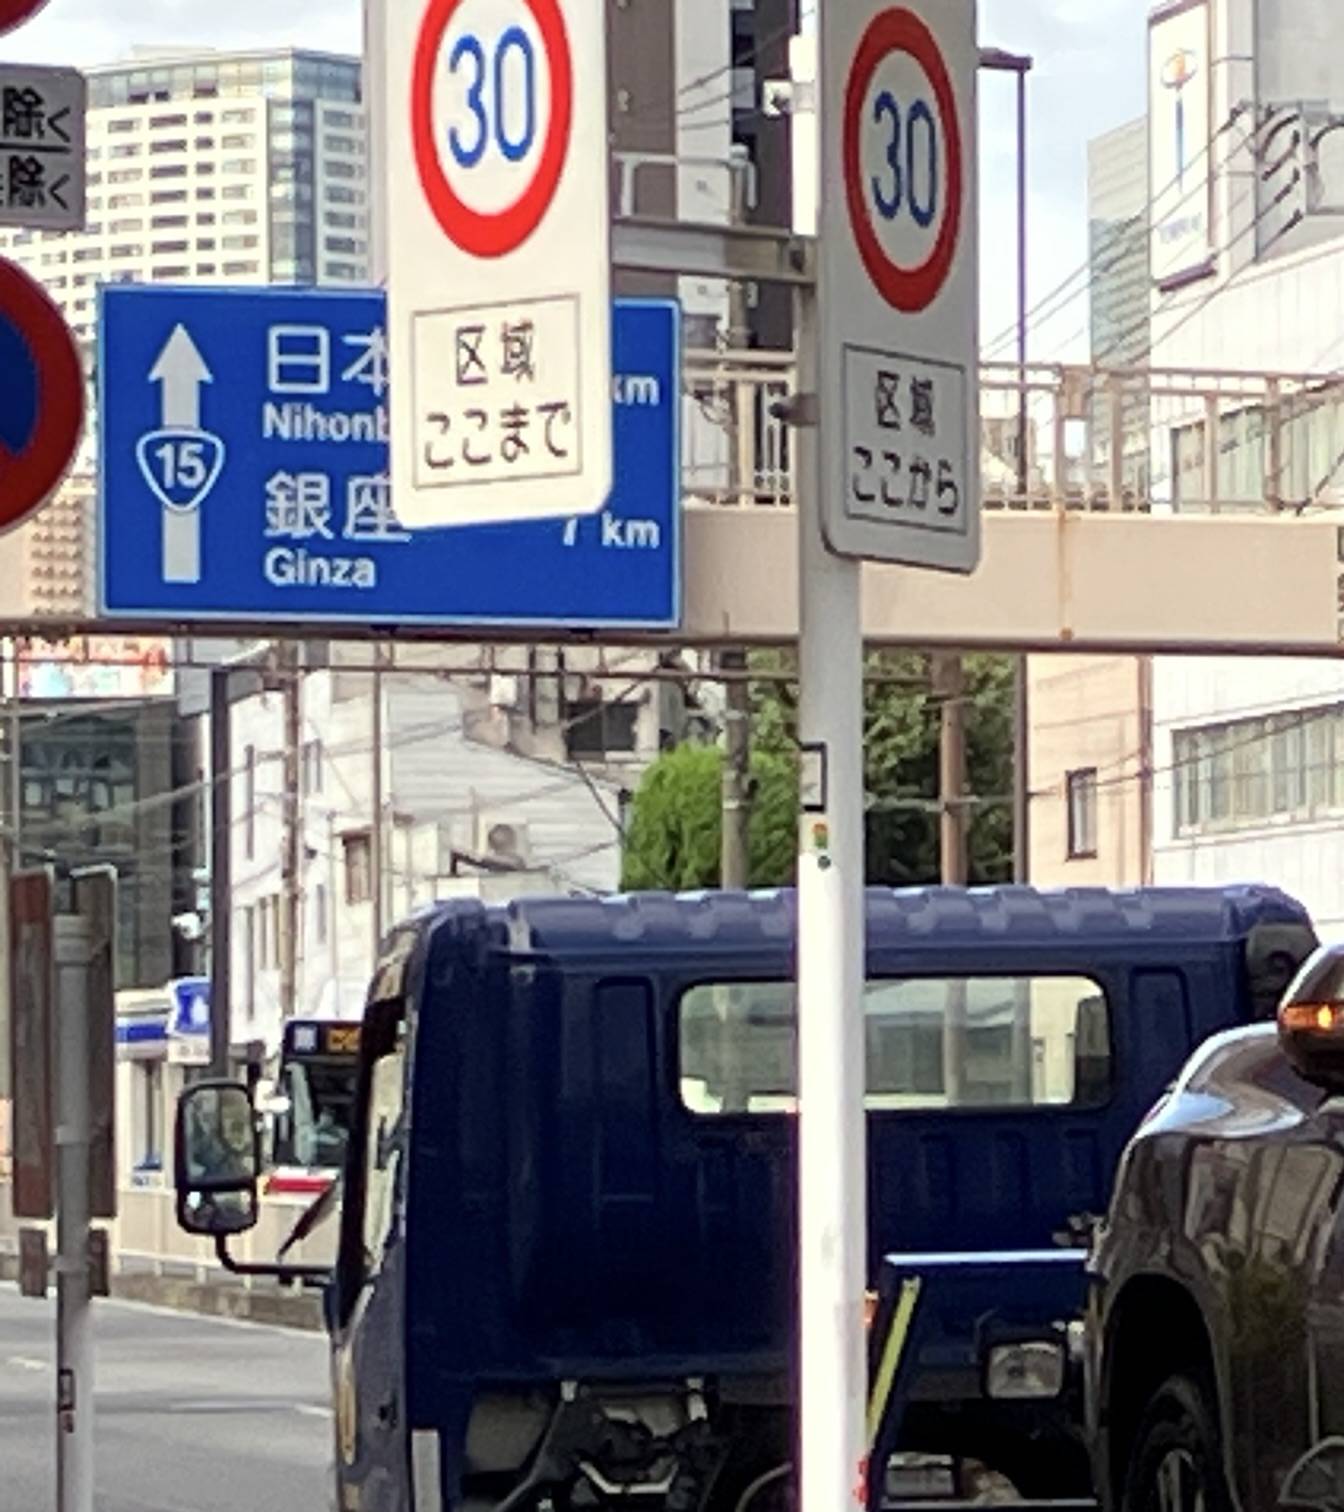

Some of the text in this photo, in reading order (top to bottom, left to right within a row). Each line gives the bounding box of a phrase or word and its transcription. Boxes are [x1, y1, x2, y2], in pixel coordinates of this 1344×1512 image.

[449, 25, 535, 169] 30
[0, 155, 70, 211] 除く
[872, 91, 936, 228] 30
[456, 319, 534, 386] 区域
[425, 402, 571, 469] ここまで
[875, 370, 935, 437] 区域
[156, 442, 206, 489] 15
[853, 446, 958, 516] ここから
[264, 470, 412, 542] 銀座
[601, 511, 660, 549] km
[264, 547, 376, 588] Ginza
